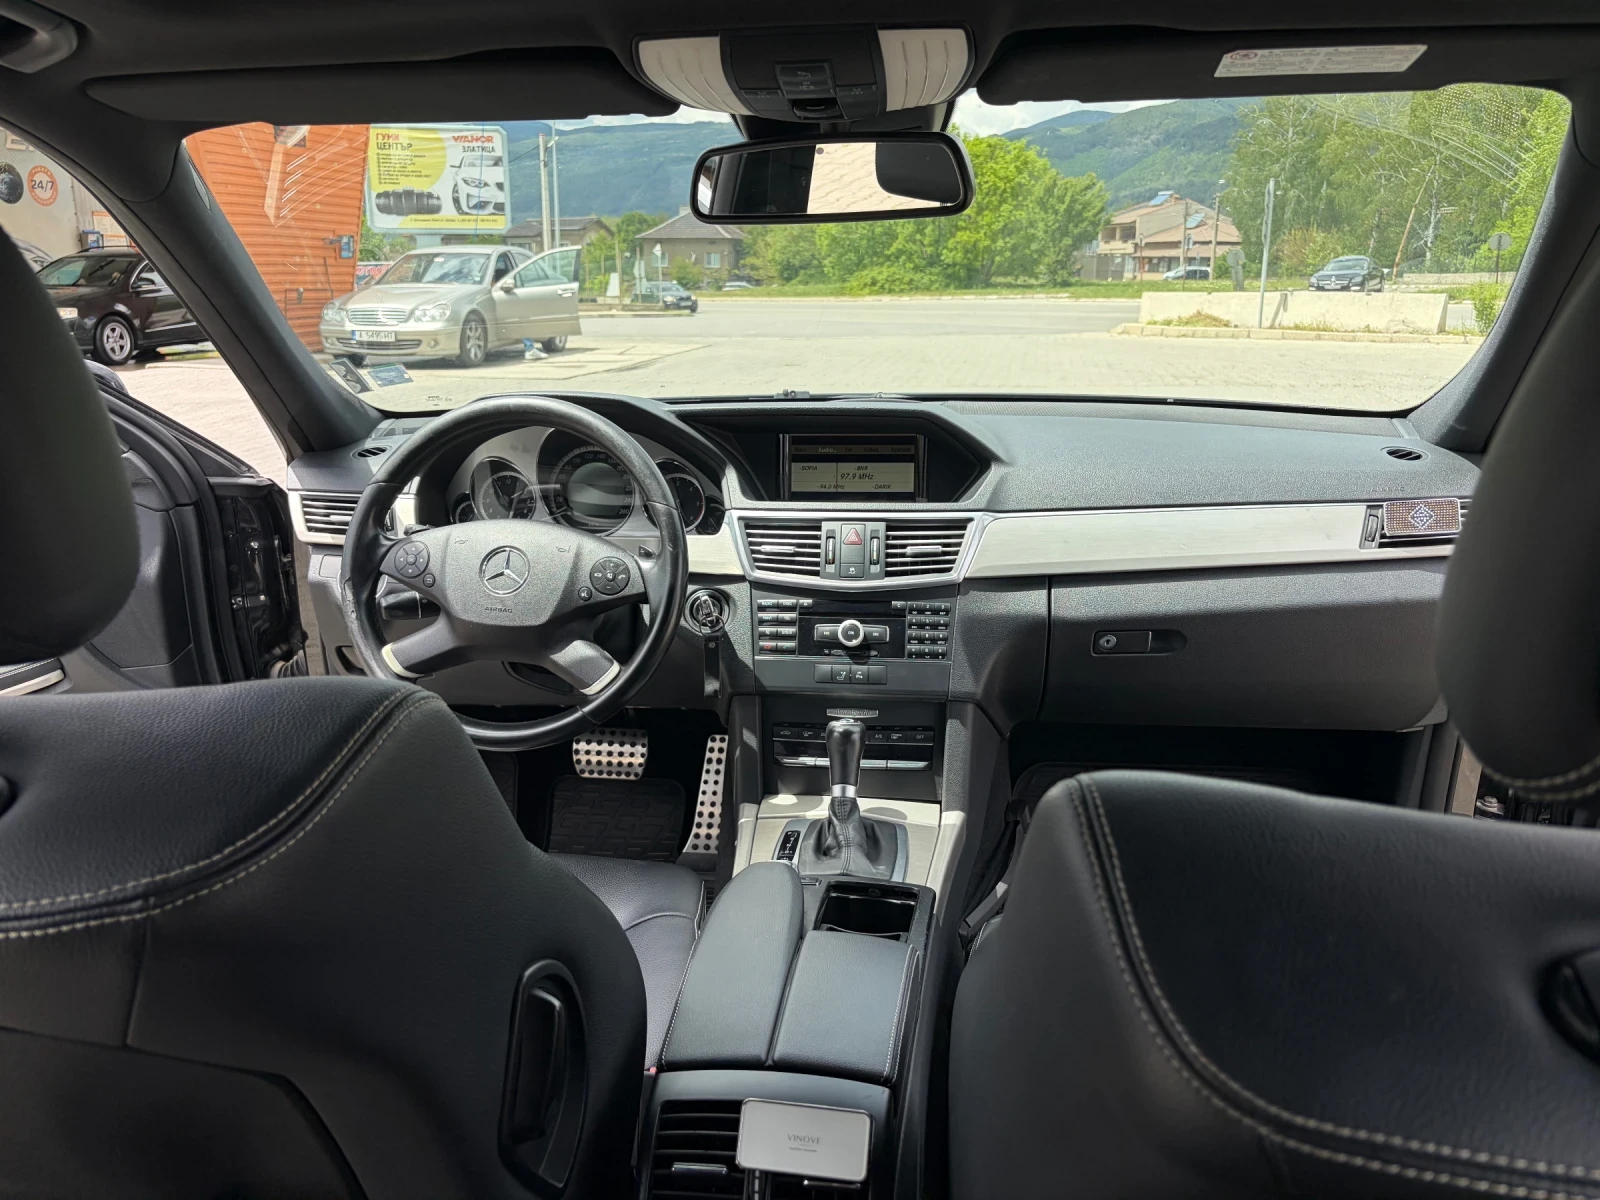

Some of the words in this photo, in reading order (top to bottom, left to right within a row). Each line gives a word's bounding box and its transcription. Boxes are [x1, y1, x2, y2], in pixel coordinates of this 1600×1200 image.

[375, 132, 400, 141] ГУМИ
[376, 142, 413, 151] ЦЕНТЪР
[461, 145, 496, 154] ЗЛАТИЦА
[30, 179, 54, 193] 24/7
[484, 606, 513, 614] AIRBAG
[787, 1133, 821, 1145] VINOVE
